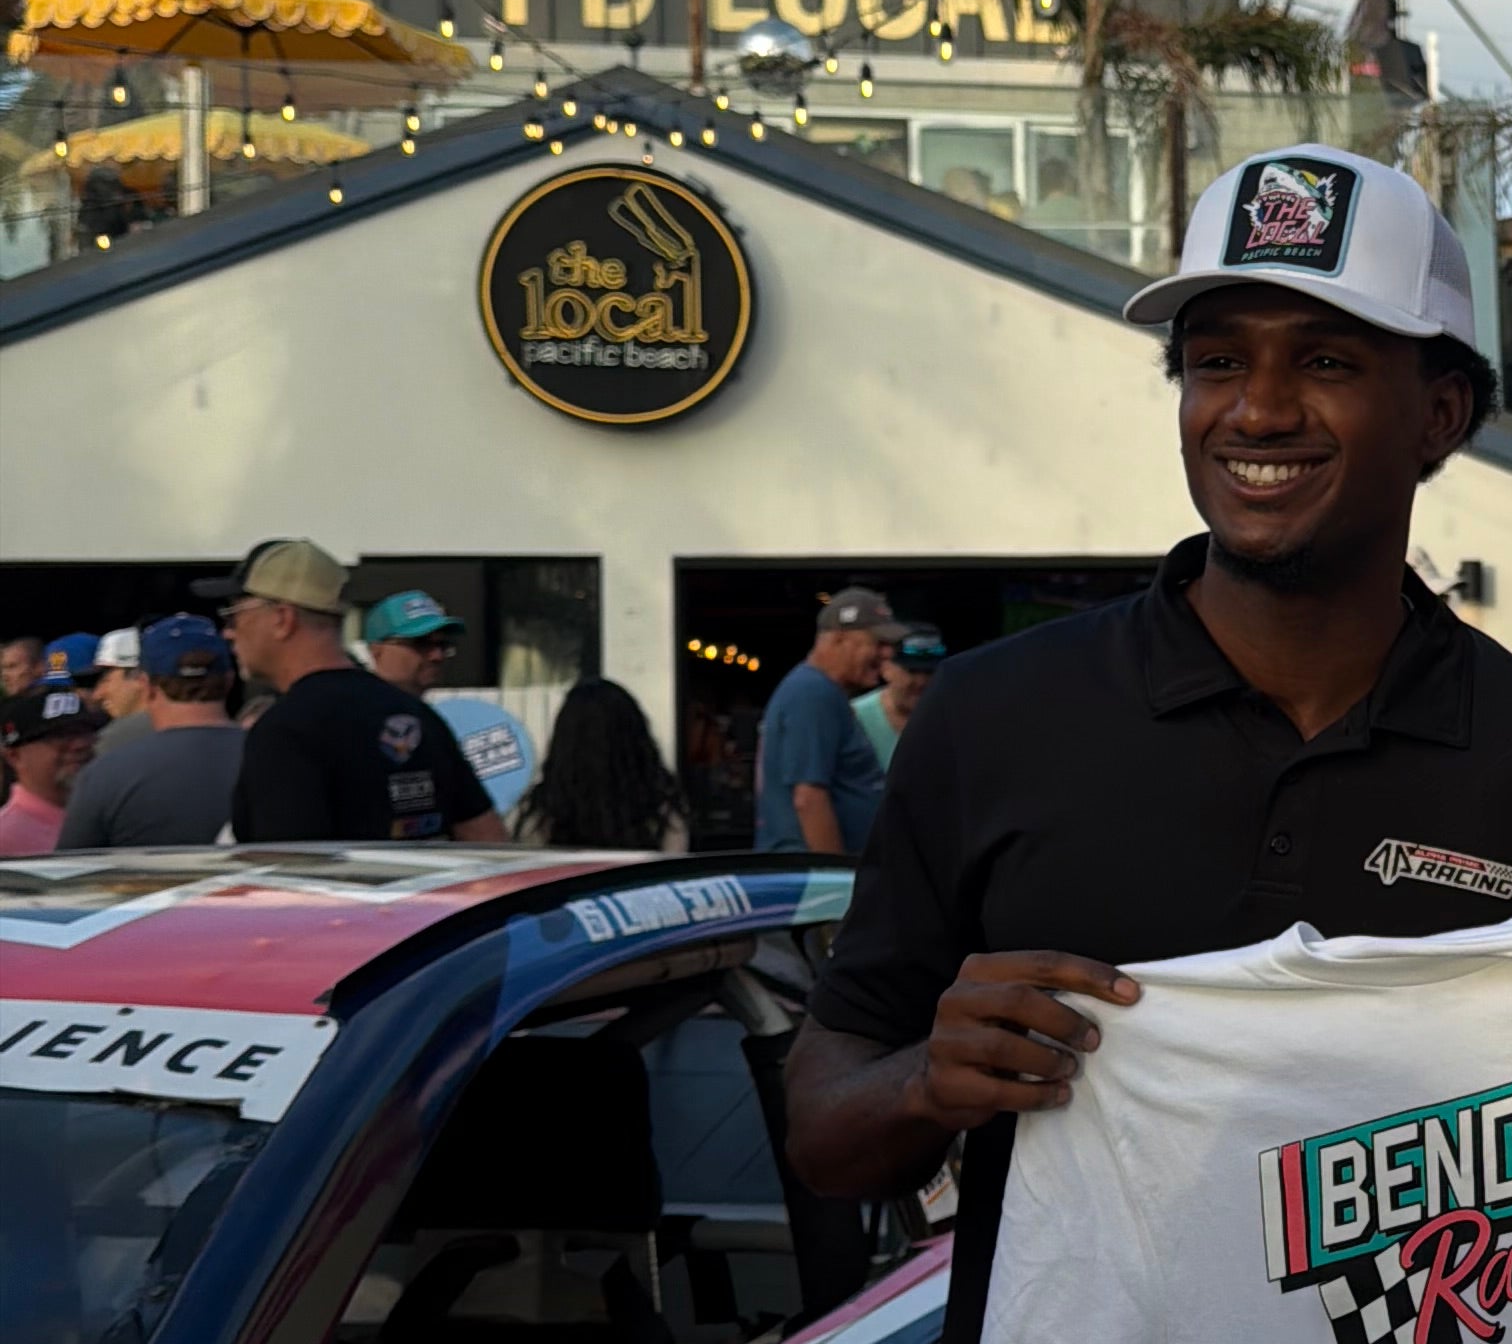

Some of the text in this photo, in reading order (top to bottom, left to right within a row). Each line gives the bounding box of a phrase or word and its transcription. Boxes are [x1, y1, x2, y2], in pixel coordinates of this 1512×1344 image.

[1262, 197, 1317, 223] THE
[1245, 220, 1325, 250] LOCAL
[546, 239, 628, 290] the
[517, 248, 709, 344] local
[520, 335, 709, 370] pacific beach
[0, 1020, 284, 1082] IENCE
